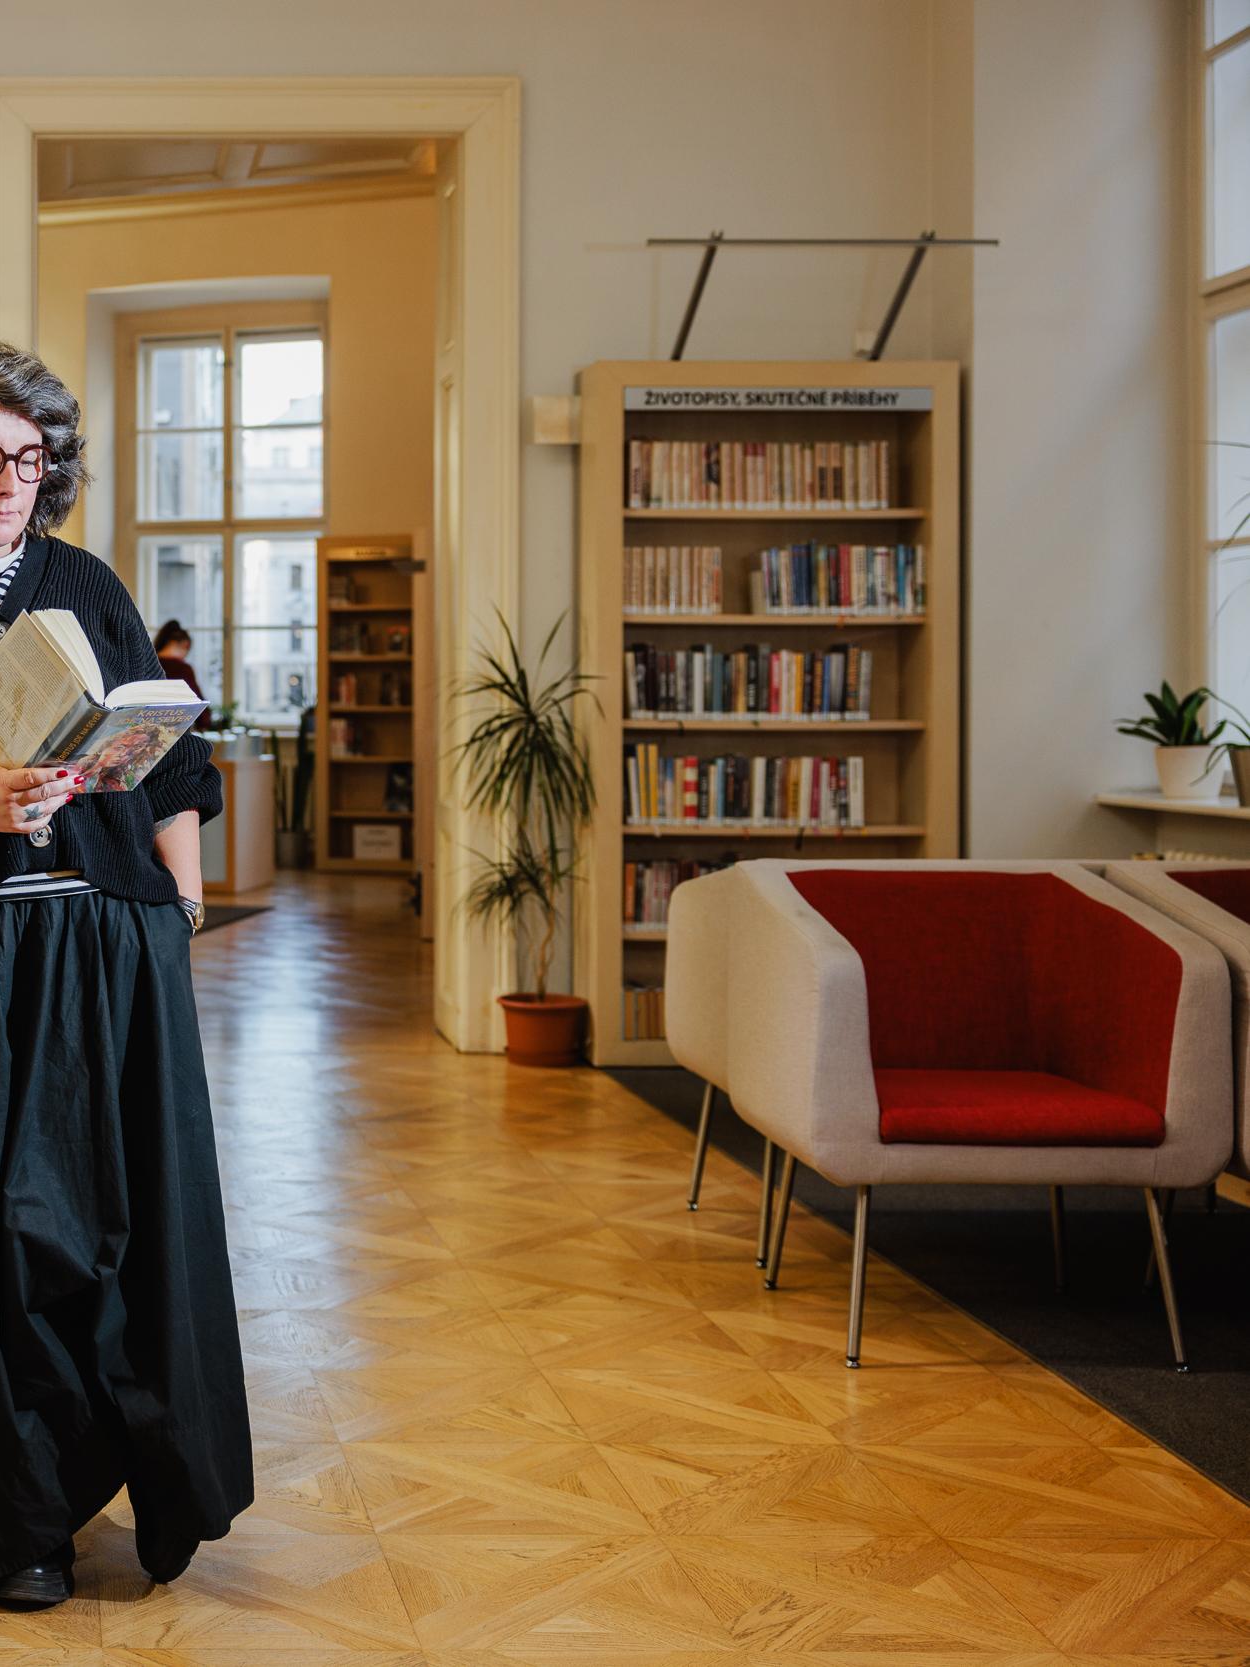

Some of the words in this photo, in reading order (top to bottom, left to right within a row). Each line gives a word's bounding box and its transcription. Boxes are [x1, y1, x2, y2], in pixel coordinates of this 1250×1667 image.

[644, 390, 742, 407] ŽIVOTOPISY,
[745, 389, 828, 406] SKUTEČNÉ
[830, 390, 899, 406] PŘÍBĚHY
[138, 708, 184, 717] KRISTUS
